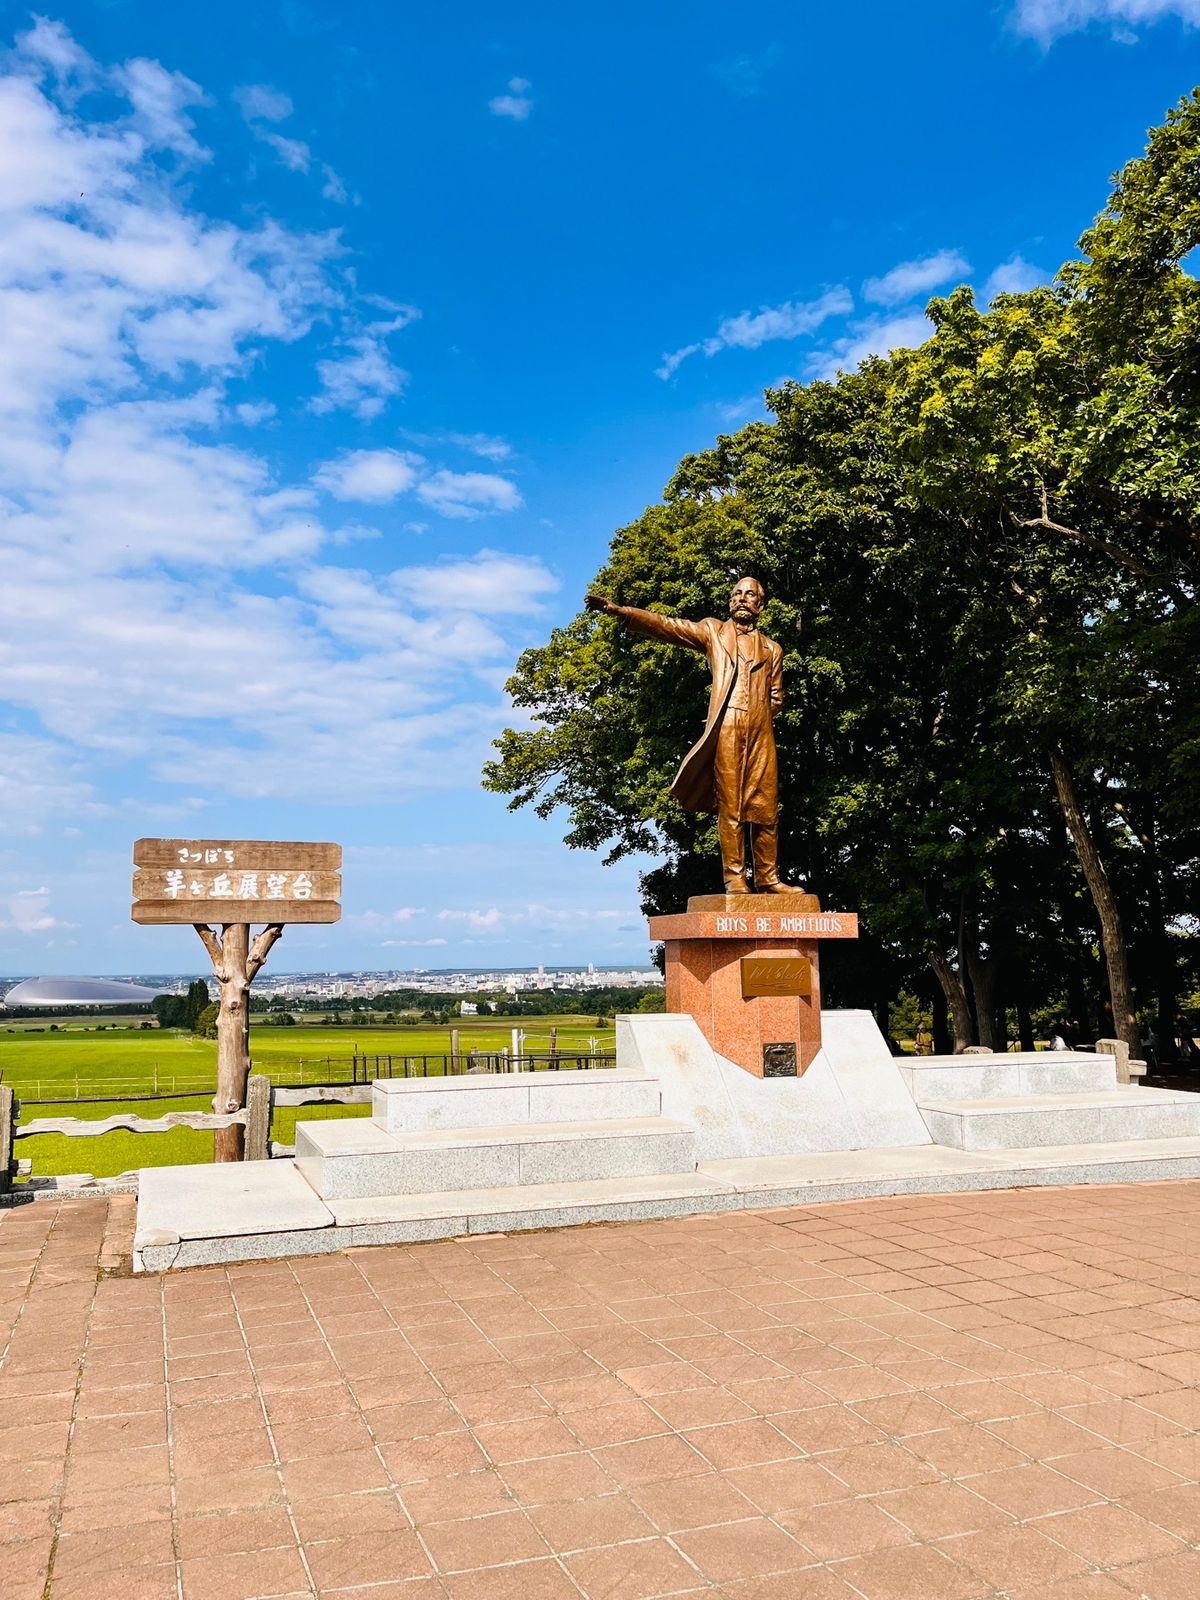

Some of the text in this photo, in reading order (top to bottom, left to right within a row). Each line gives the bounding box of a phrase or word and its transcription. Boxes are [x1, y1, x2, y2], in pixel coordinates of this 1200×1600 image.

[178, 848, 235, 864] さっぽろ
[716, 917, 842, 932] BOYS BE AMBITIOUS
